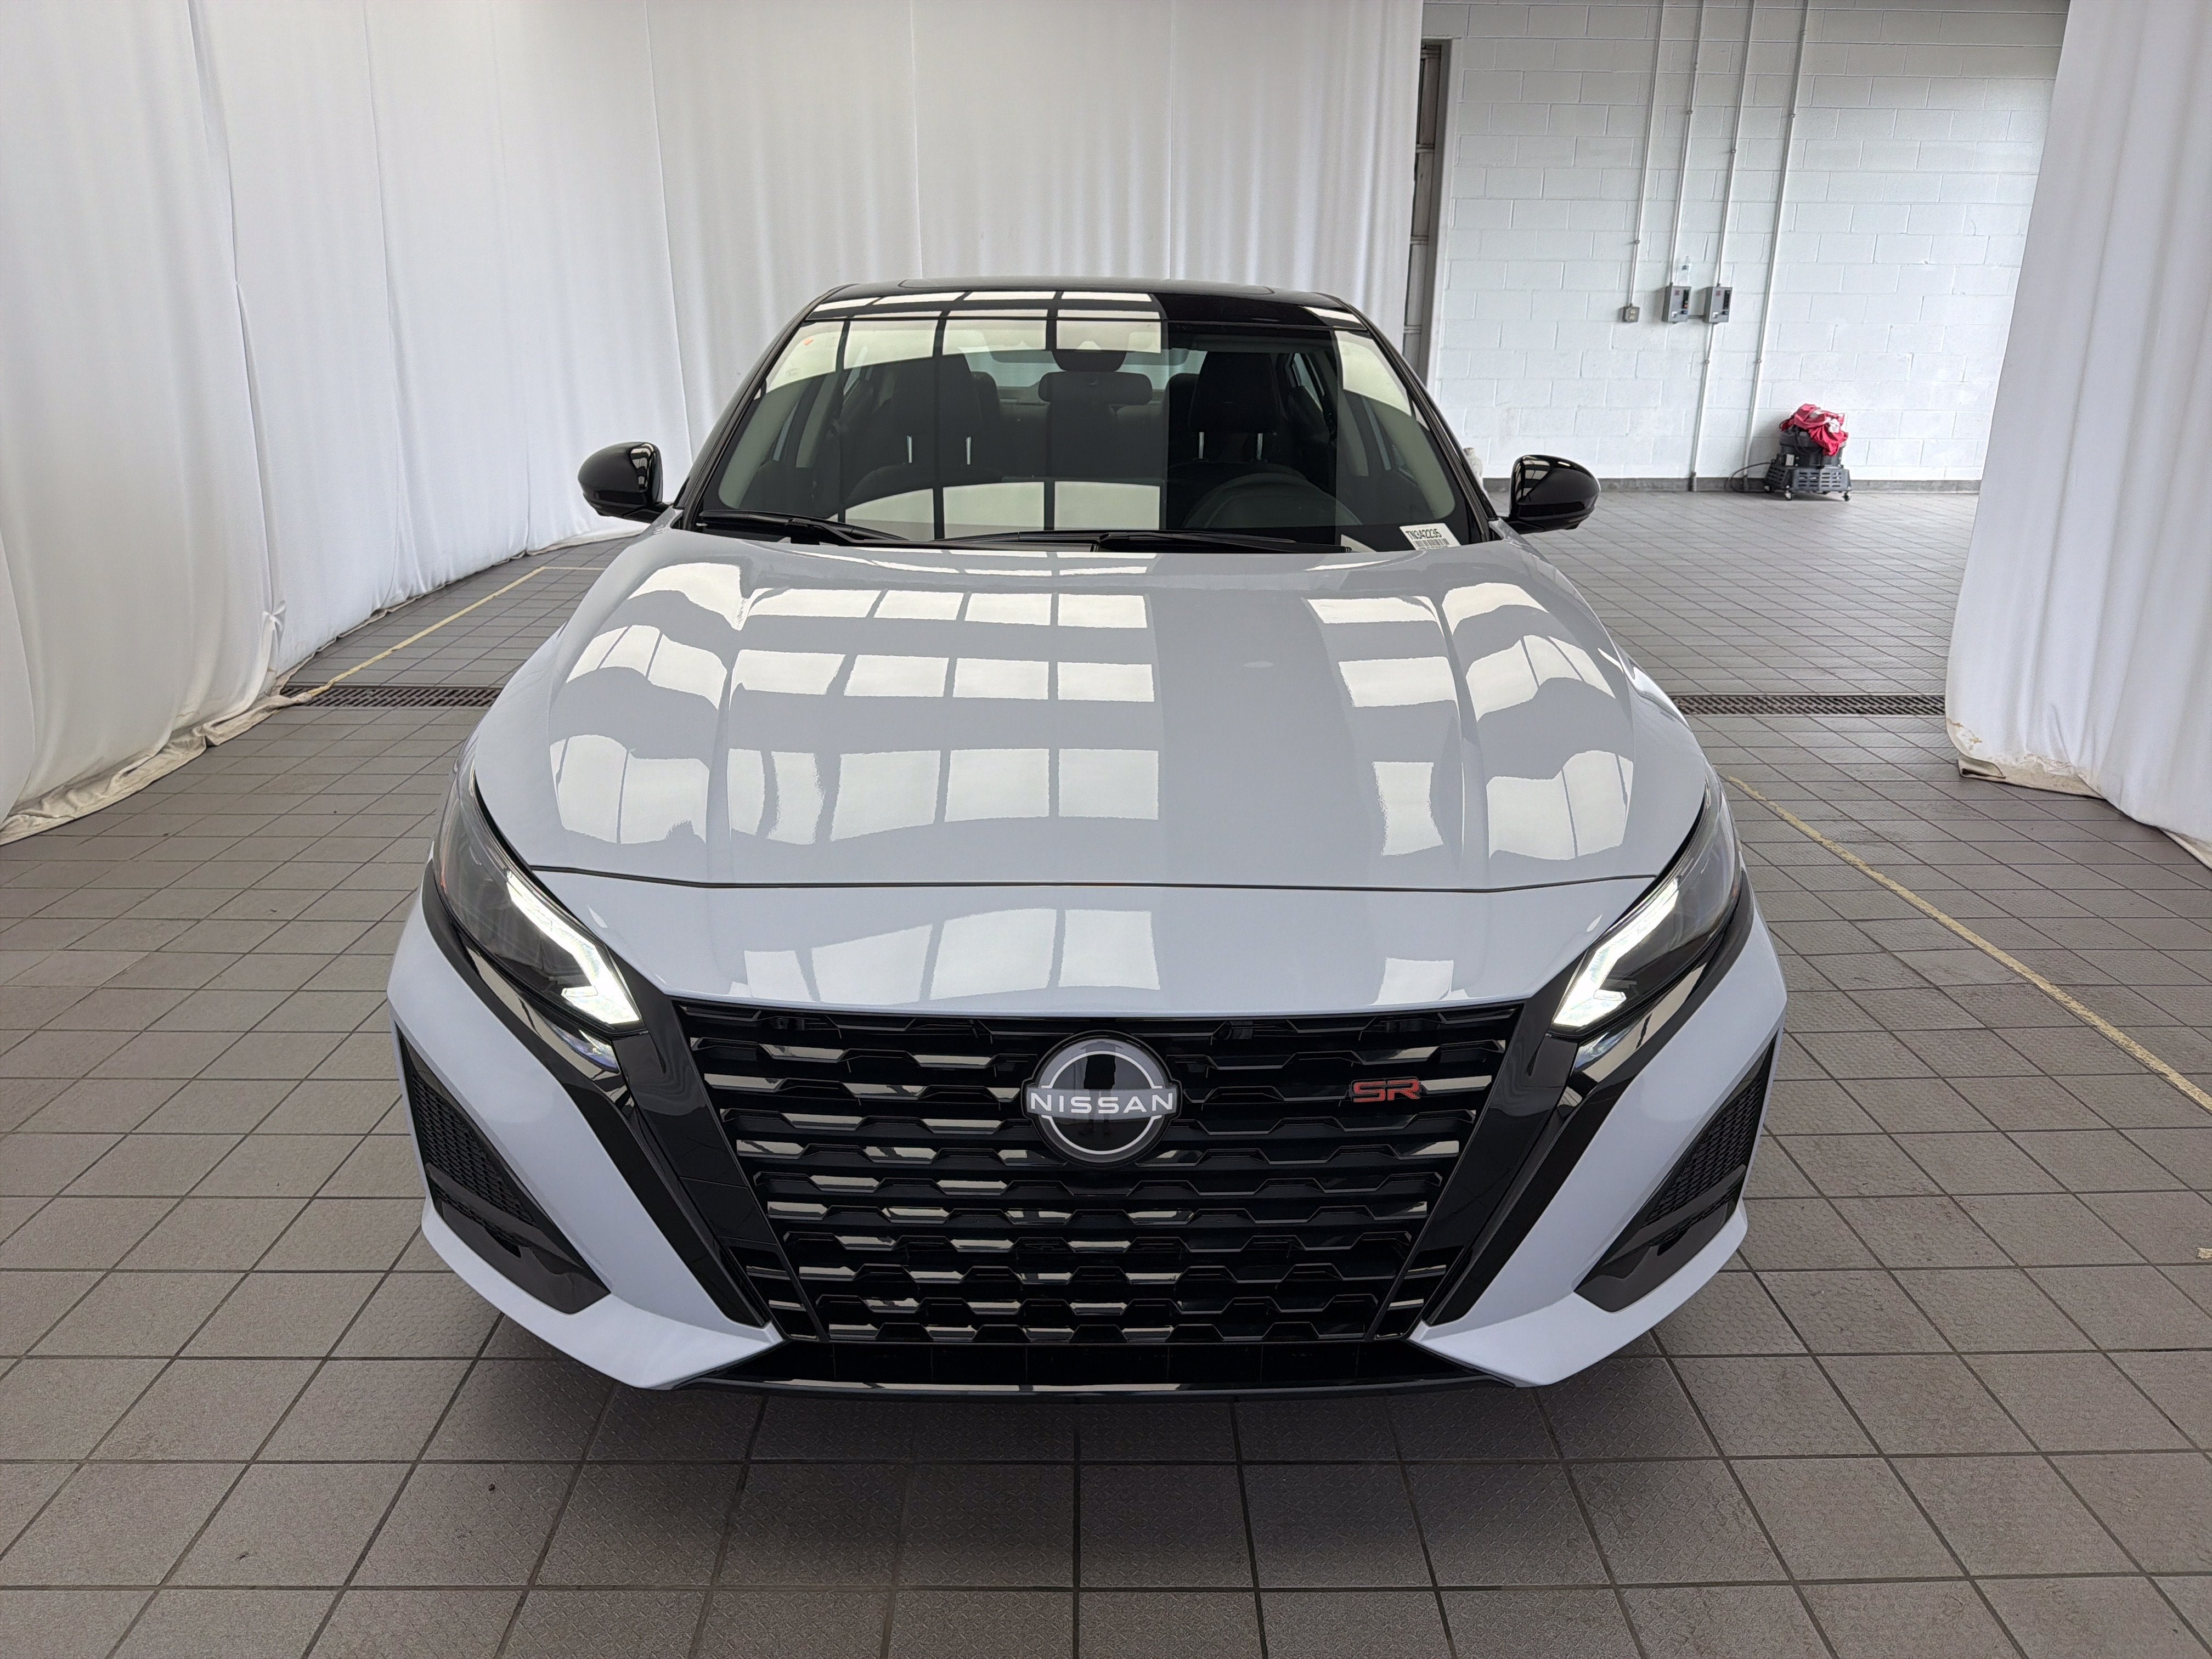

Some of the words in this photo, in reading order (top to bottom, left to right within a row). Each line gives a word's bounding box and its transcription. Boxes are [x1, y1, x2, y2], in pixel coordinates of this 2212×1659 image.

[1406, 528, 1442, 540] TN342235
[1353, 1079, 1421, 1103] SR
[1030, 1092, 1173, 1114] NISSAN
